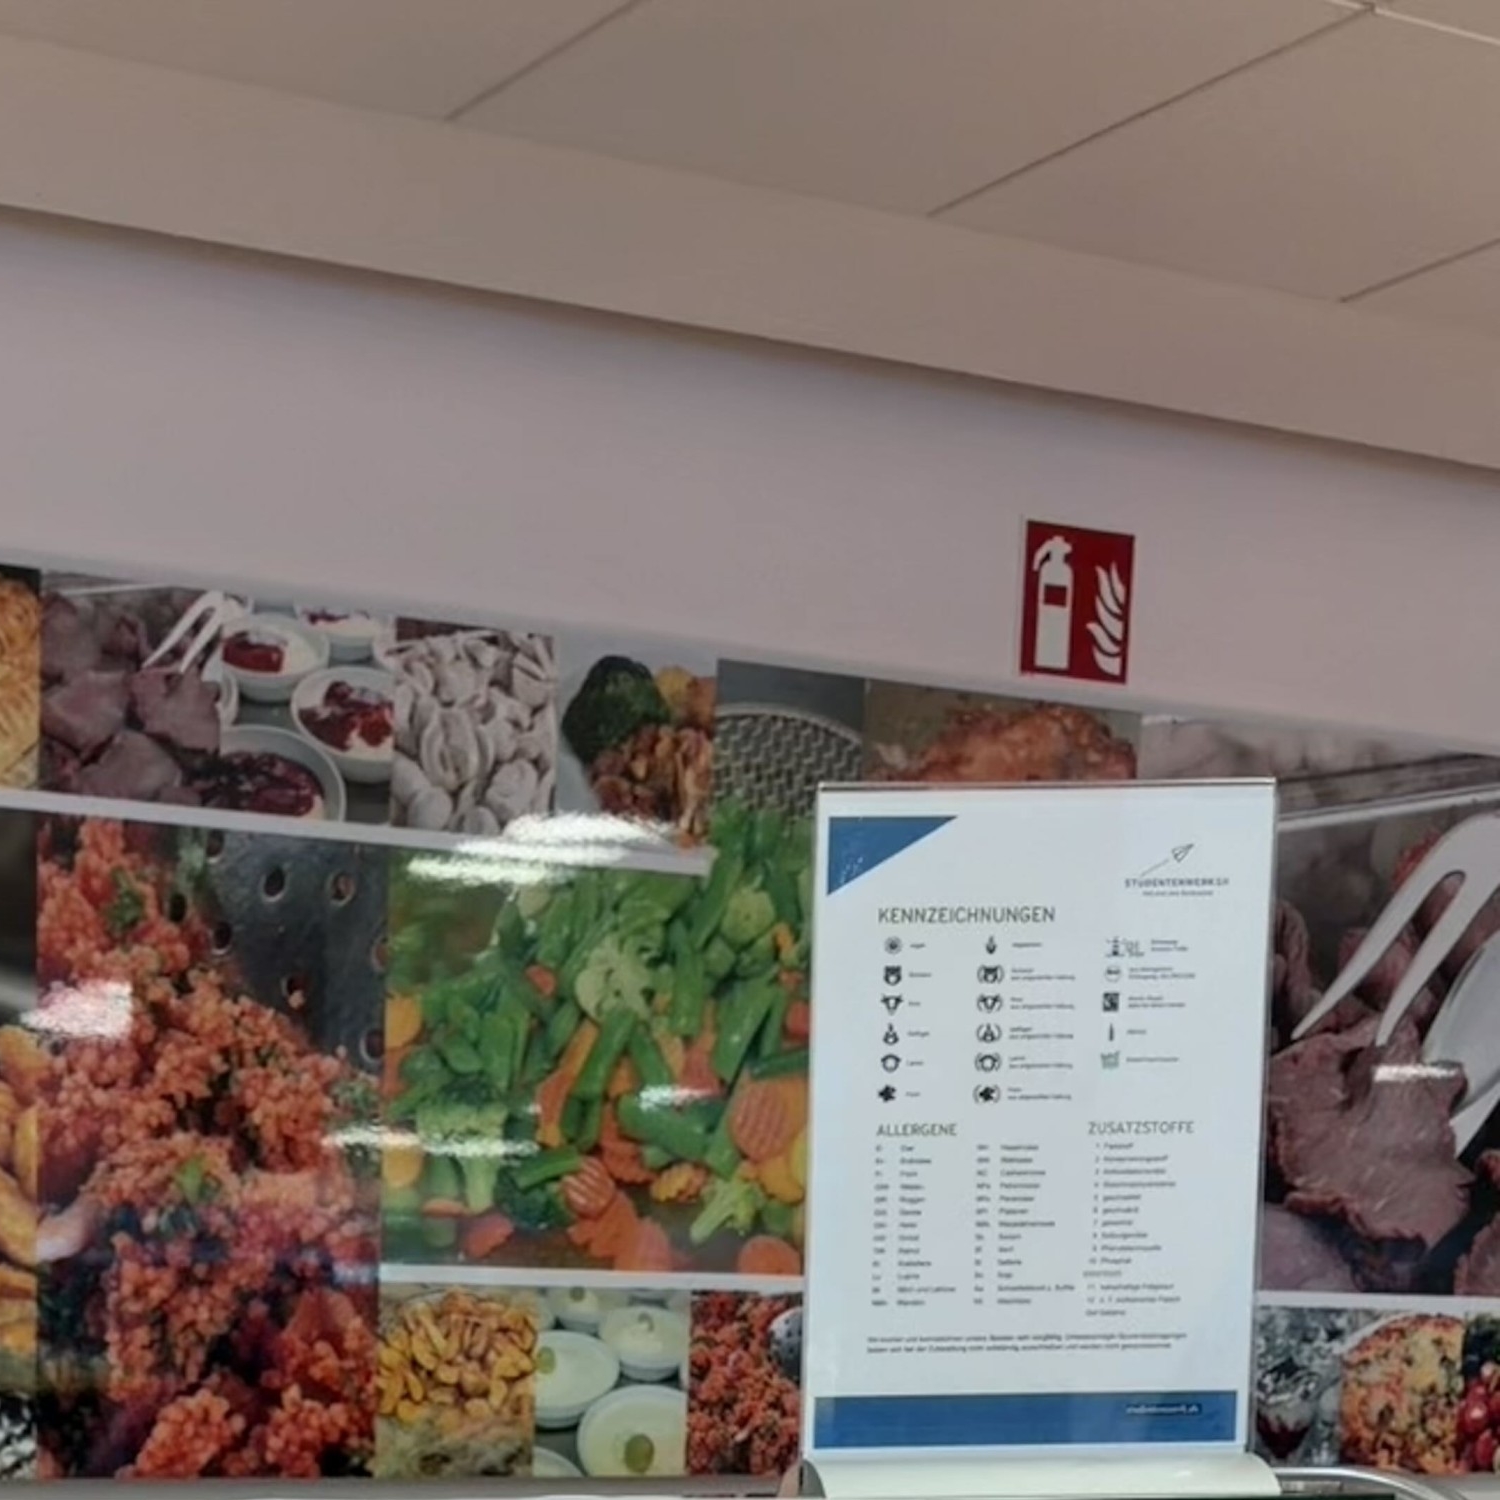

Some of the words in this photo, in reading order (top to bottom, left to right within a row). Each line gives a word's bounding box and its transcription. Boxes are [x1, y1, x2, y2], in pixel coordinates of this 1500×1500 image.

[878, 907, 1056, 925] KENNZEICHNUNGEN
[876, 1123, 958, 1137] ALLERGENE
[1088, 1121, 1195, 1135] ZUSATZSTOFFE
